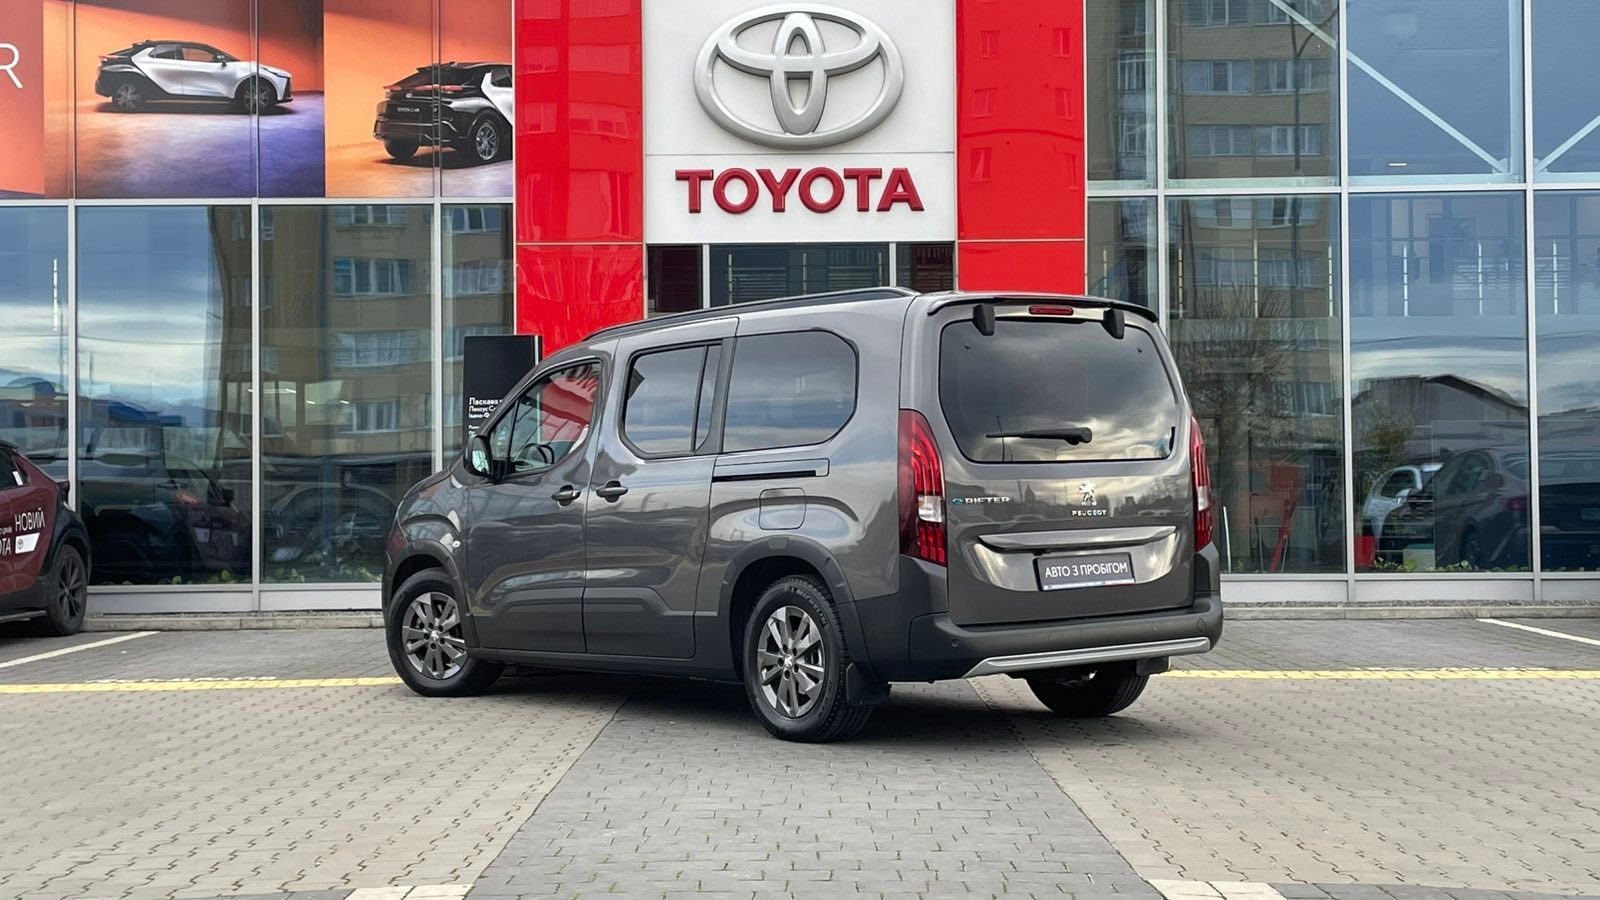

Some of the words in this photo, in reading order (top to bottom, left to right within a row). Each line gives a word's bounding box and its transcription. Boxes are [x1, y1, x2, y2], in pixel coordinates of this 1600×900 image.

[0, 42, 23, 89] R
[675, 166, 925, 214] TOYOTA
[14, 507, 46, 532] НОВИЙ
[1045, 566, 1071, 578] АВТО
[1080, 562, 1128, 575] ПРОБІГОМ
[796, 589, 829, 627] MICHELIN
